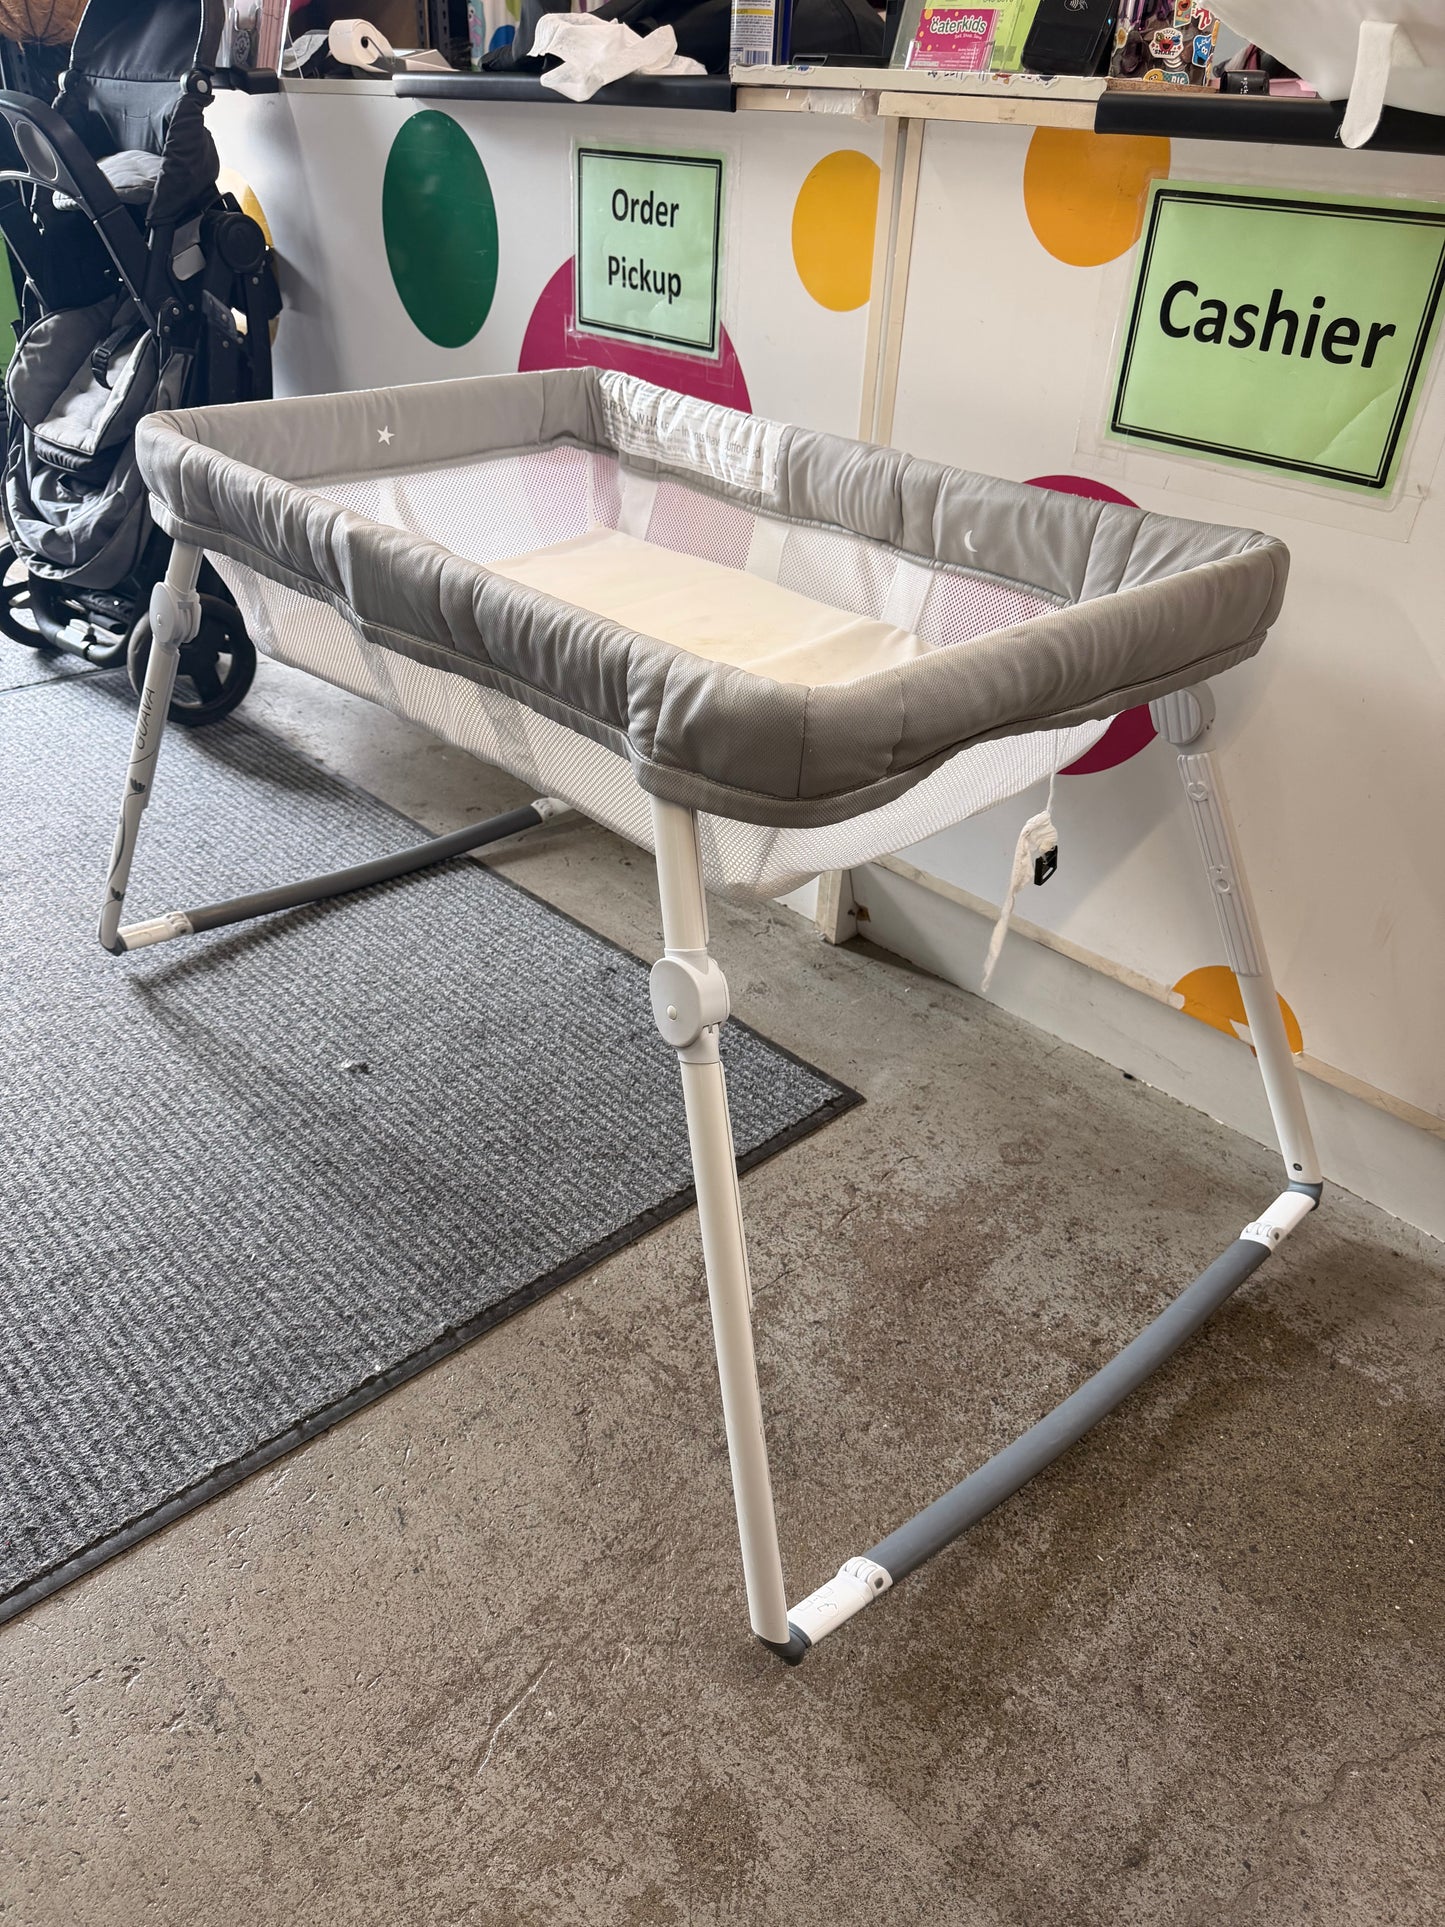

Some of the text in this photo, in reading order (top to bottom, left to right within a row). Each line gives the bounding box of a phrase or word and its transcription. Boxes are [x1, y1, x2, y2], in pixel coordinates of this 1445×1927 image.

[612, 188, 679, 228] Order
[608, 255, 682, 304] Pickup
[1159, 280, 1397, 368] Cashier
[136, 687, 155, 750] GUAVA
